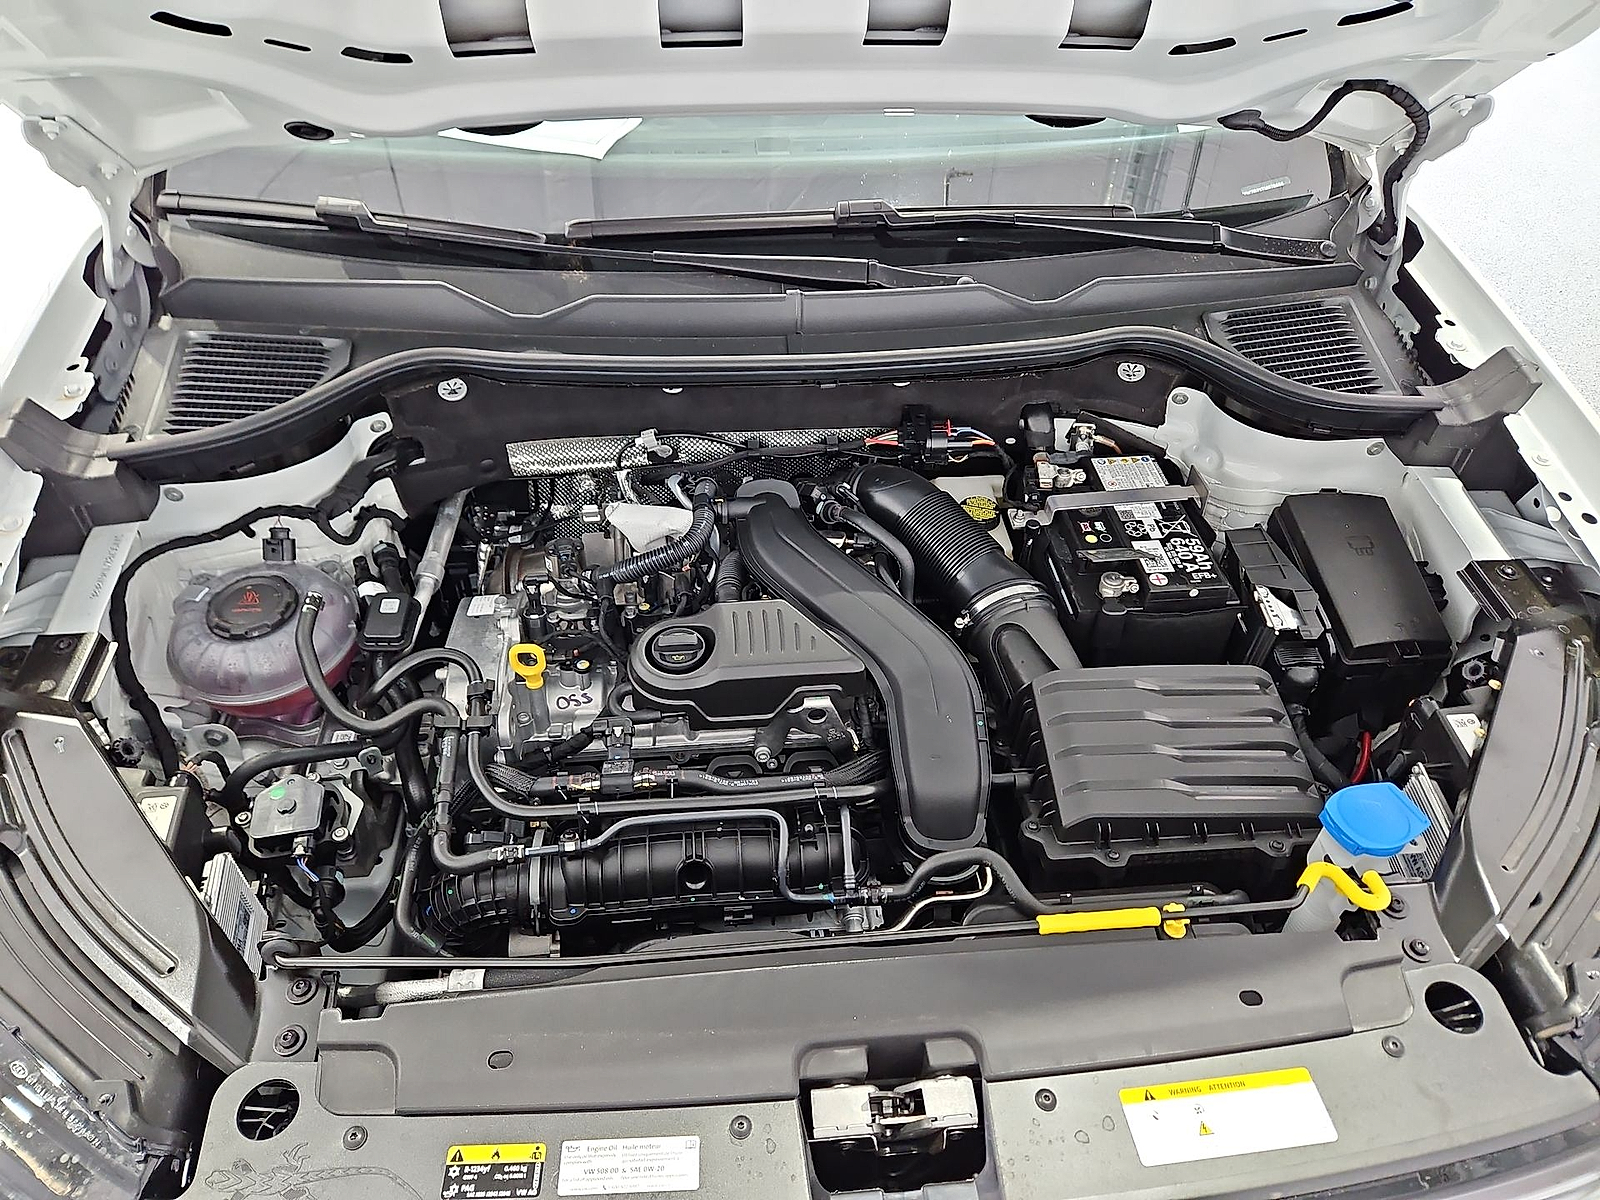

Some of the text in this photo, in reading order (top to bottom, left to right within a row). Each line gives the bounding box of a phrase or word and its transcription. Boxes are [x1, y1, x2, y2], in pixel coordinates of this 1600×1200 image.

[1170, 537, 1194, 559] 640
[1182, 562, 1200, 573] A
[1185, 537, 1213, 570] 59Ah
[1168, 1080, 1246, 1096] WARNING ATTENTION
